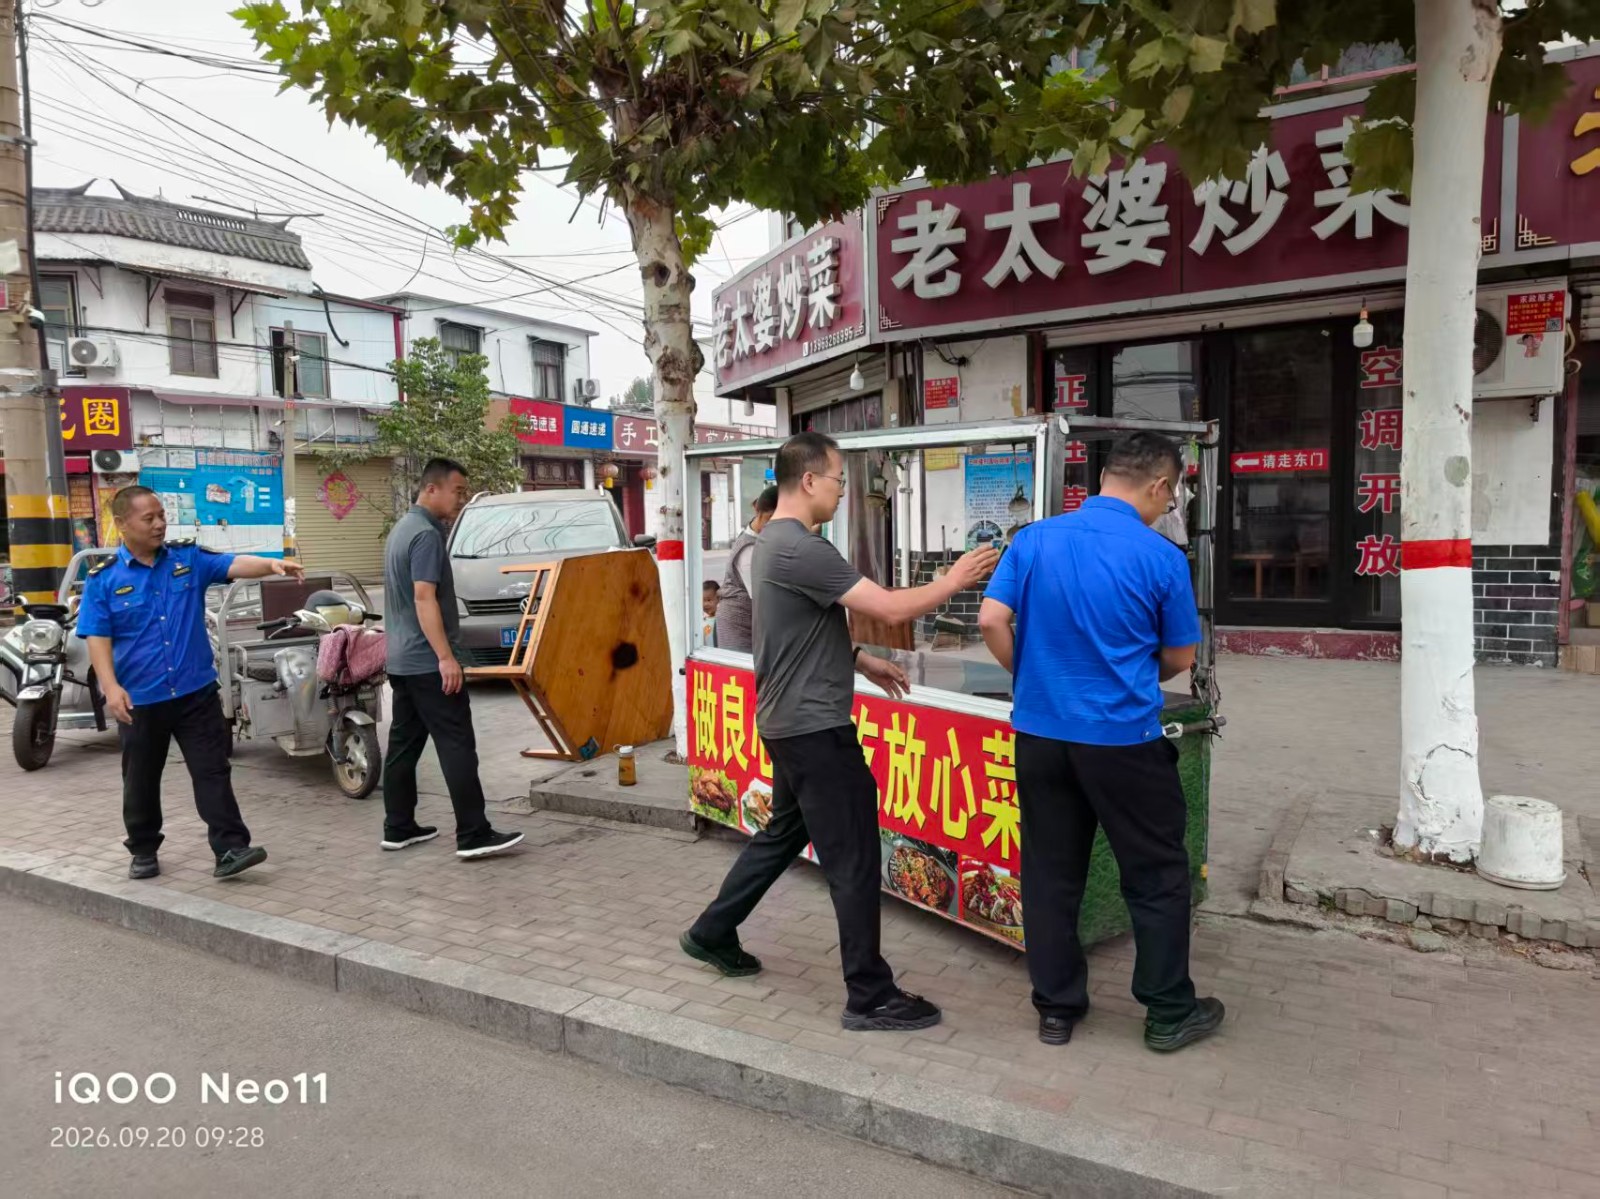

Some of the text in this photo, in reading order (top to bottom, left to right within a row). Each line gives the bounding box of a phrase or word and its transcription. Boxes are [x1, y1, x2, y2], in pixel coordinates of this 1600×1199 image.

[891, 115, 1411, 298] 老太婆炒菜
[713, 236, 841, 369] 老太婆炒菜
[620, 421, 659, 446] 手工
[1262, 452, 1324, 469] 请走东门
[1355, 346, 1403, 577] 空调开放
